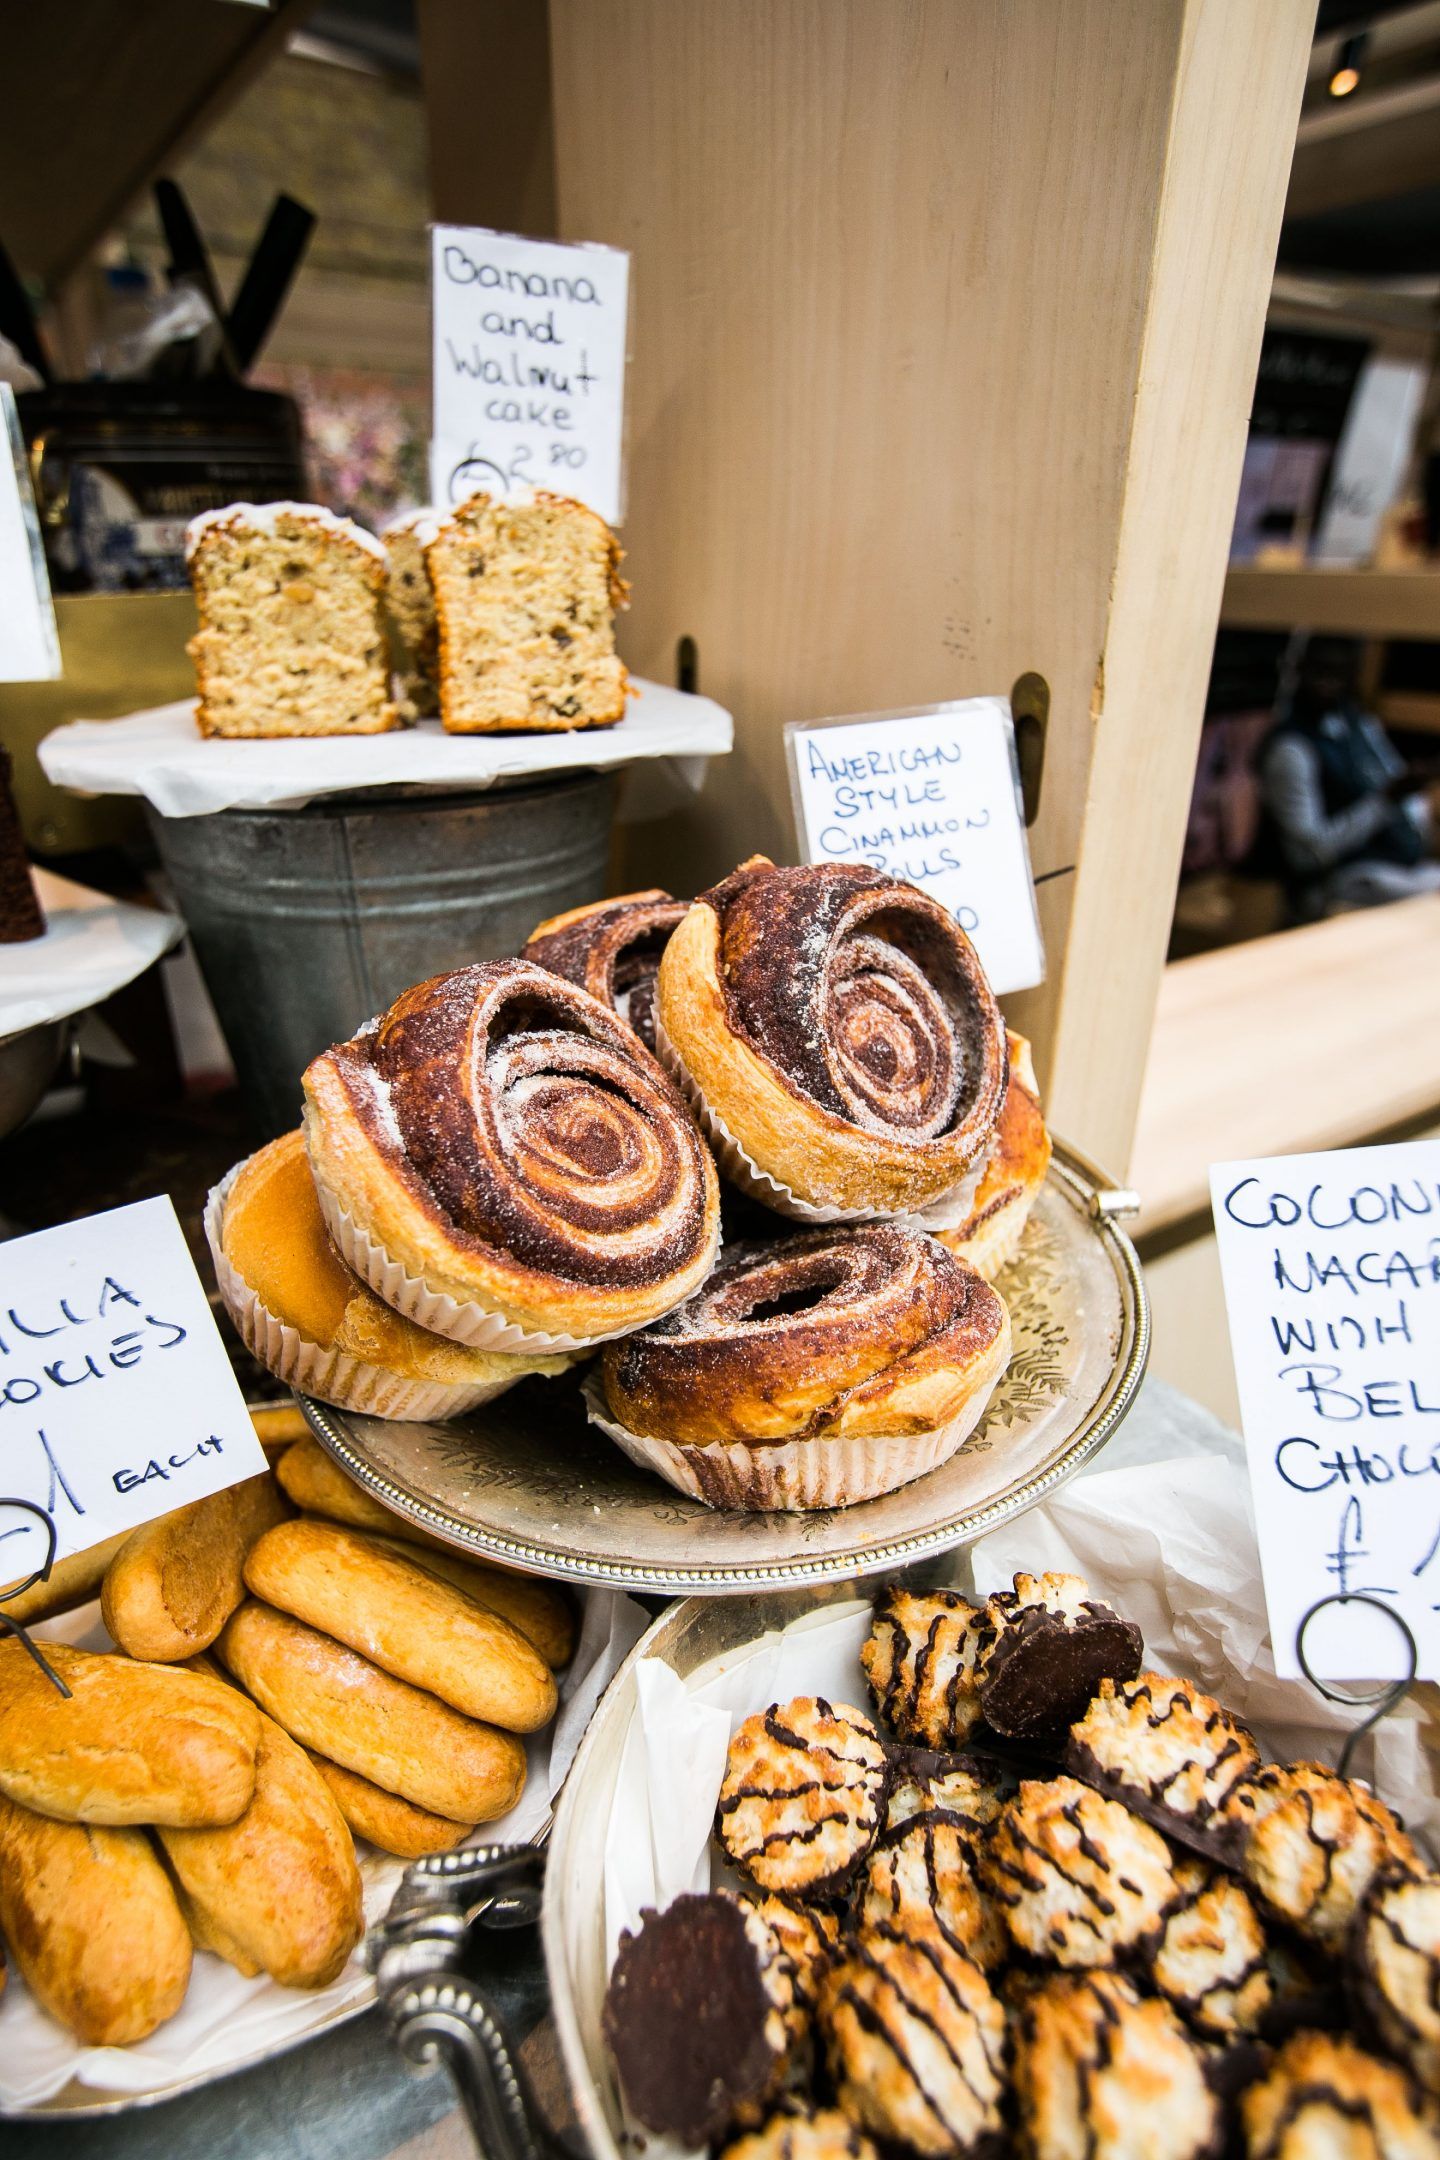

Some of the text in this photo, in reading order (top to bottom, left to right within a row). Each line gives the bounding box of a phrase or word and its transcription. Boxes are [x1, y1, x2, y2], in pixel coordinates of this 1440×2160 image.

[444, 246, 601, 306] Banana
[481, 311, 563, 345] and
[446, 339, 597, 396] Walnut
[485, 400, 575, 430] cake
[807, 740, 961, 783] AMERICAN
[834, 780, 946, 818] STYLE
[820, 809, 990, 854] CINAMMON
[1225, 1178, 1440, 1229] COCON
[1271, 1299, 1412, 1355] WITH
[0, 1315, 187, 1409] OKIES
[112, 1435, 223, 1493] EACH
